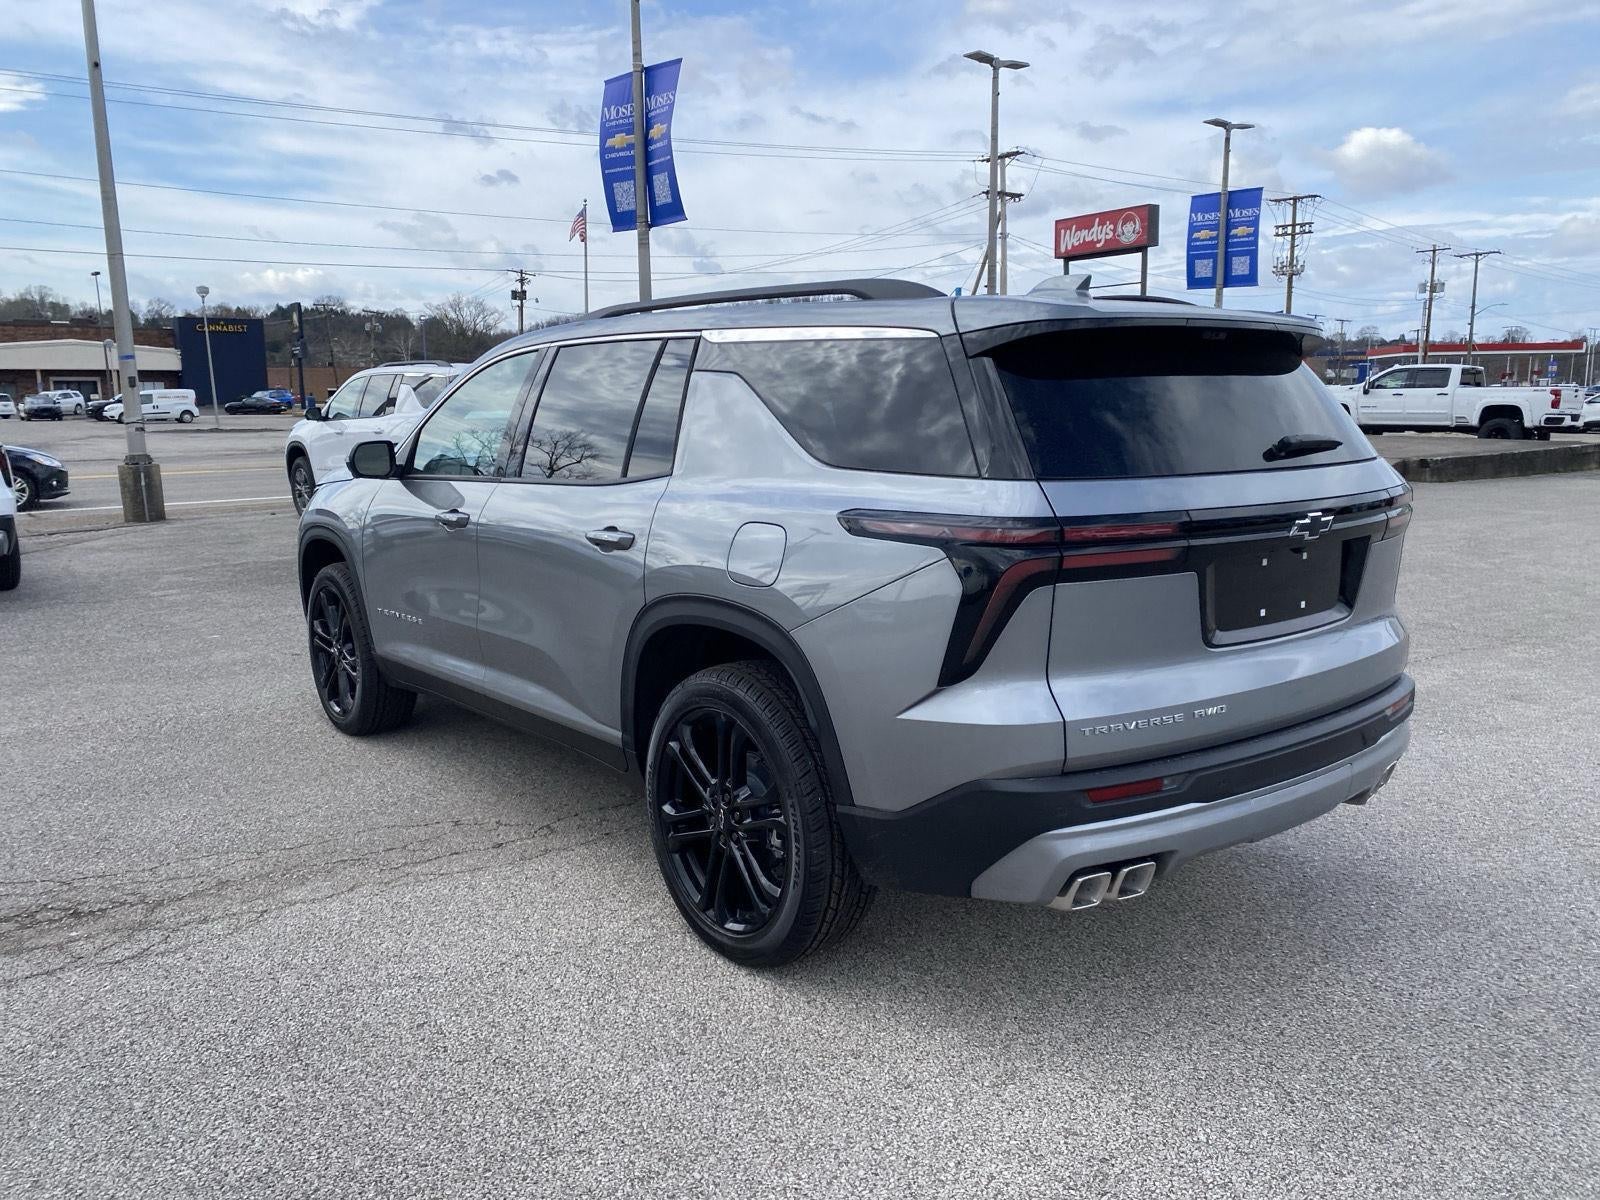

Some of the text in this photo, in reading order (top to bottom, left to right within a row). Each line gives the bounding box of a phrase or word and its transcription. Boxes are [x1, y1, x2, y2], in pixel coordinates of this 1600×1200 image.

[646, 92, 675, 111] MOSES
[603, 104, 635, 121] MOSE
[605, 149, 636, 159] CHEVROLE
[1228, 207, 1260, 218] MOSES
[1060, 218, 1113, 253] Wendy's
[1081, 704, 1226, 736] TRAVERSE AWD
